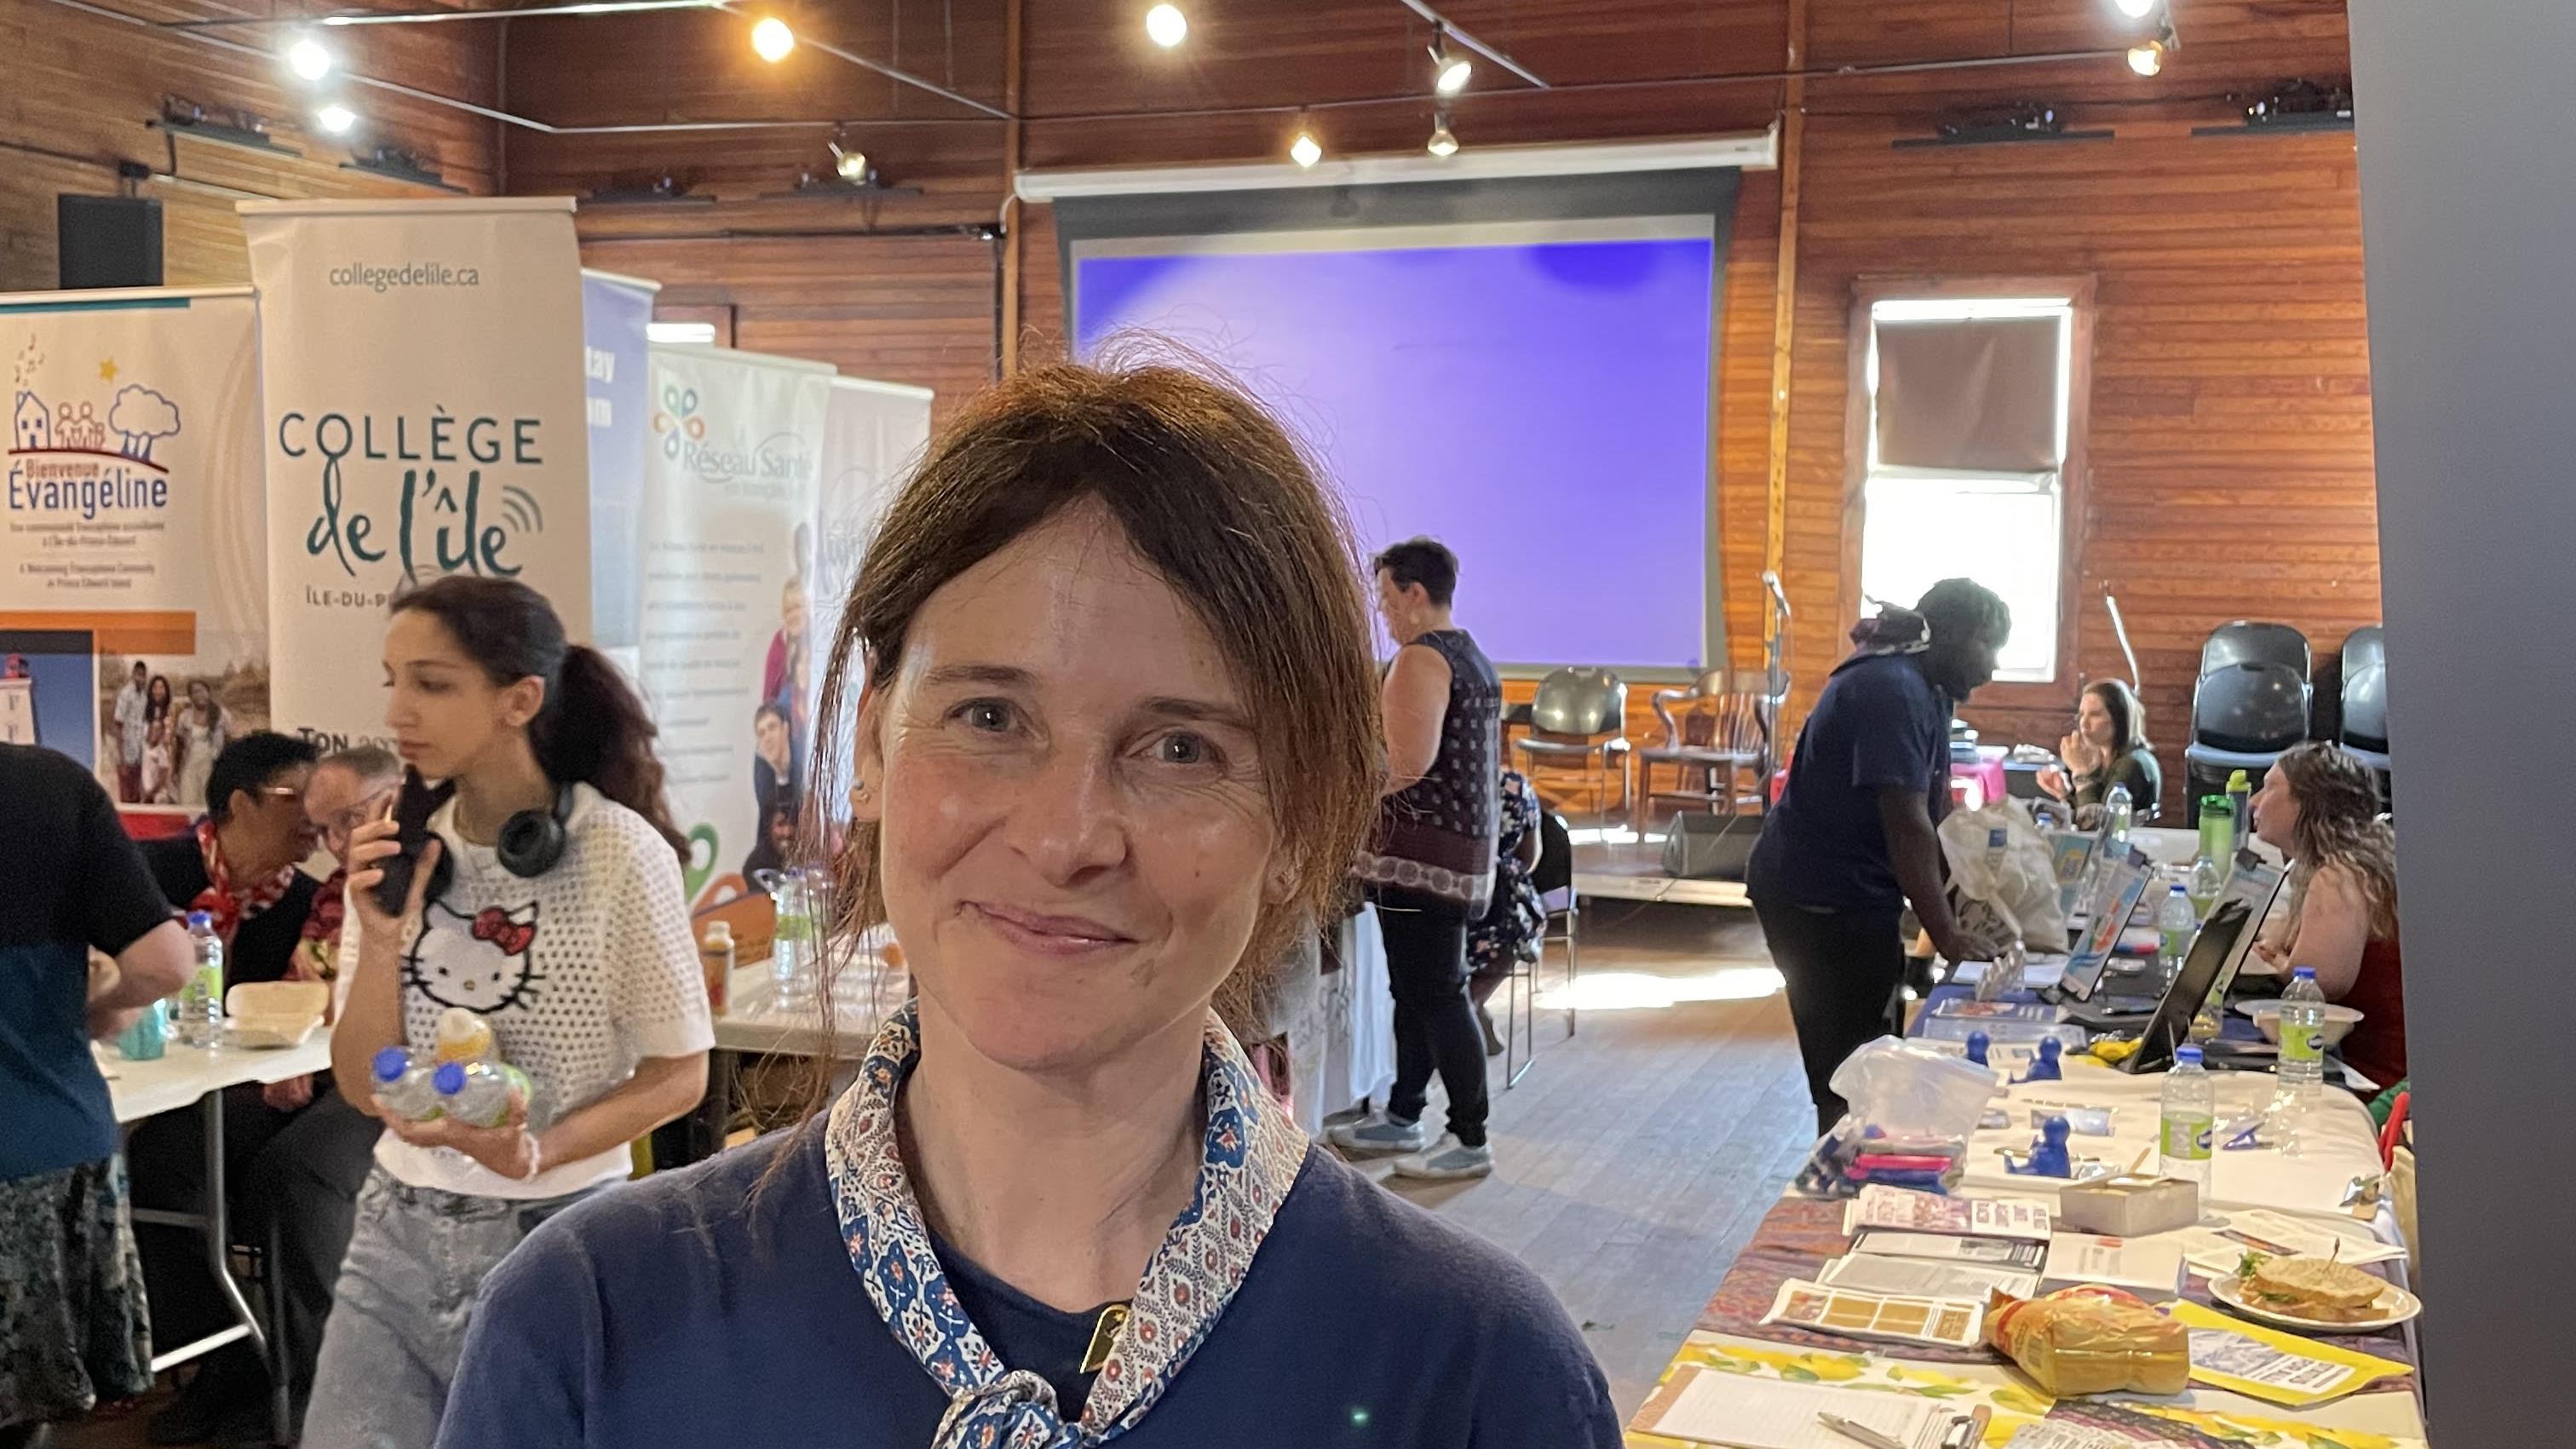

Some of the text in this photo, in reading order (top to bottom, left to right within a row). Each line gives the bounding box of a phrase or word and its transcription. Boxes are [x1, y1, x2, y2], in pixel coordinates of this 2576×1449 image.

[330, 262, 480, 294] collegedelile.ca
[279, 404, 543, 464] COLLÈGE
[26, 458, 100, 479] Bienvenue
[682, 441, 756, 477] Réseau
[9, 459, 168, 520] Évangéline
[307, 457, 387, 578] de
[306, 584, 388, 607] ÎLE-DU-P
